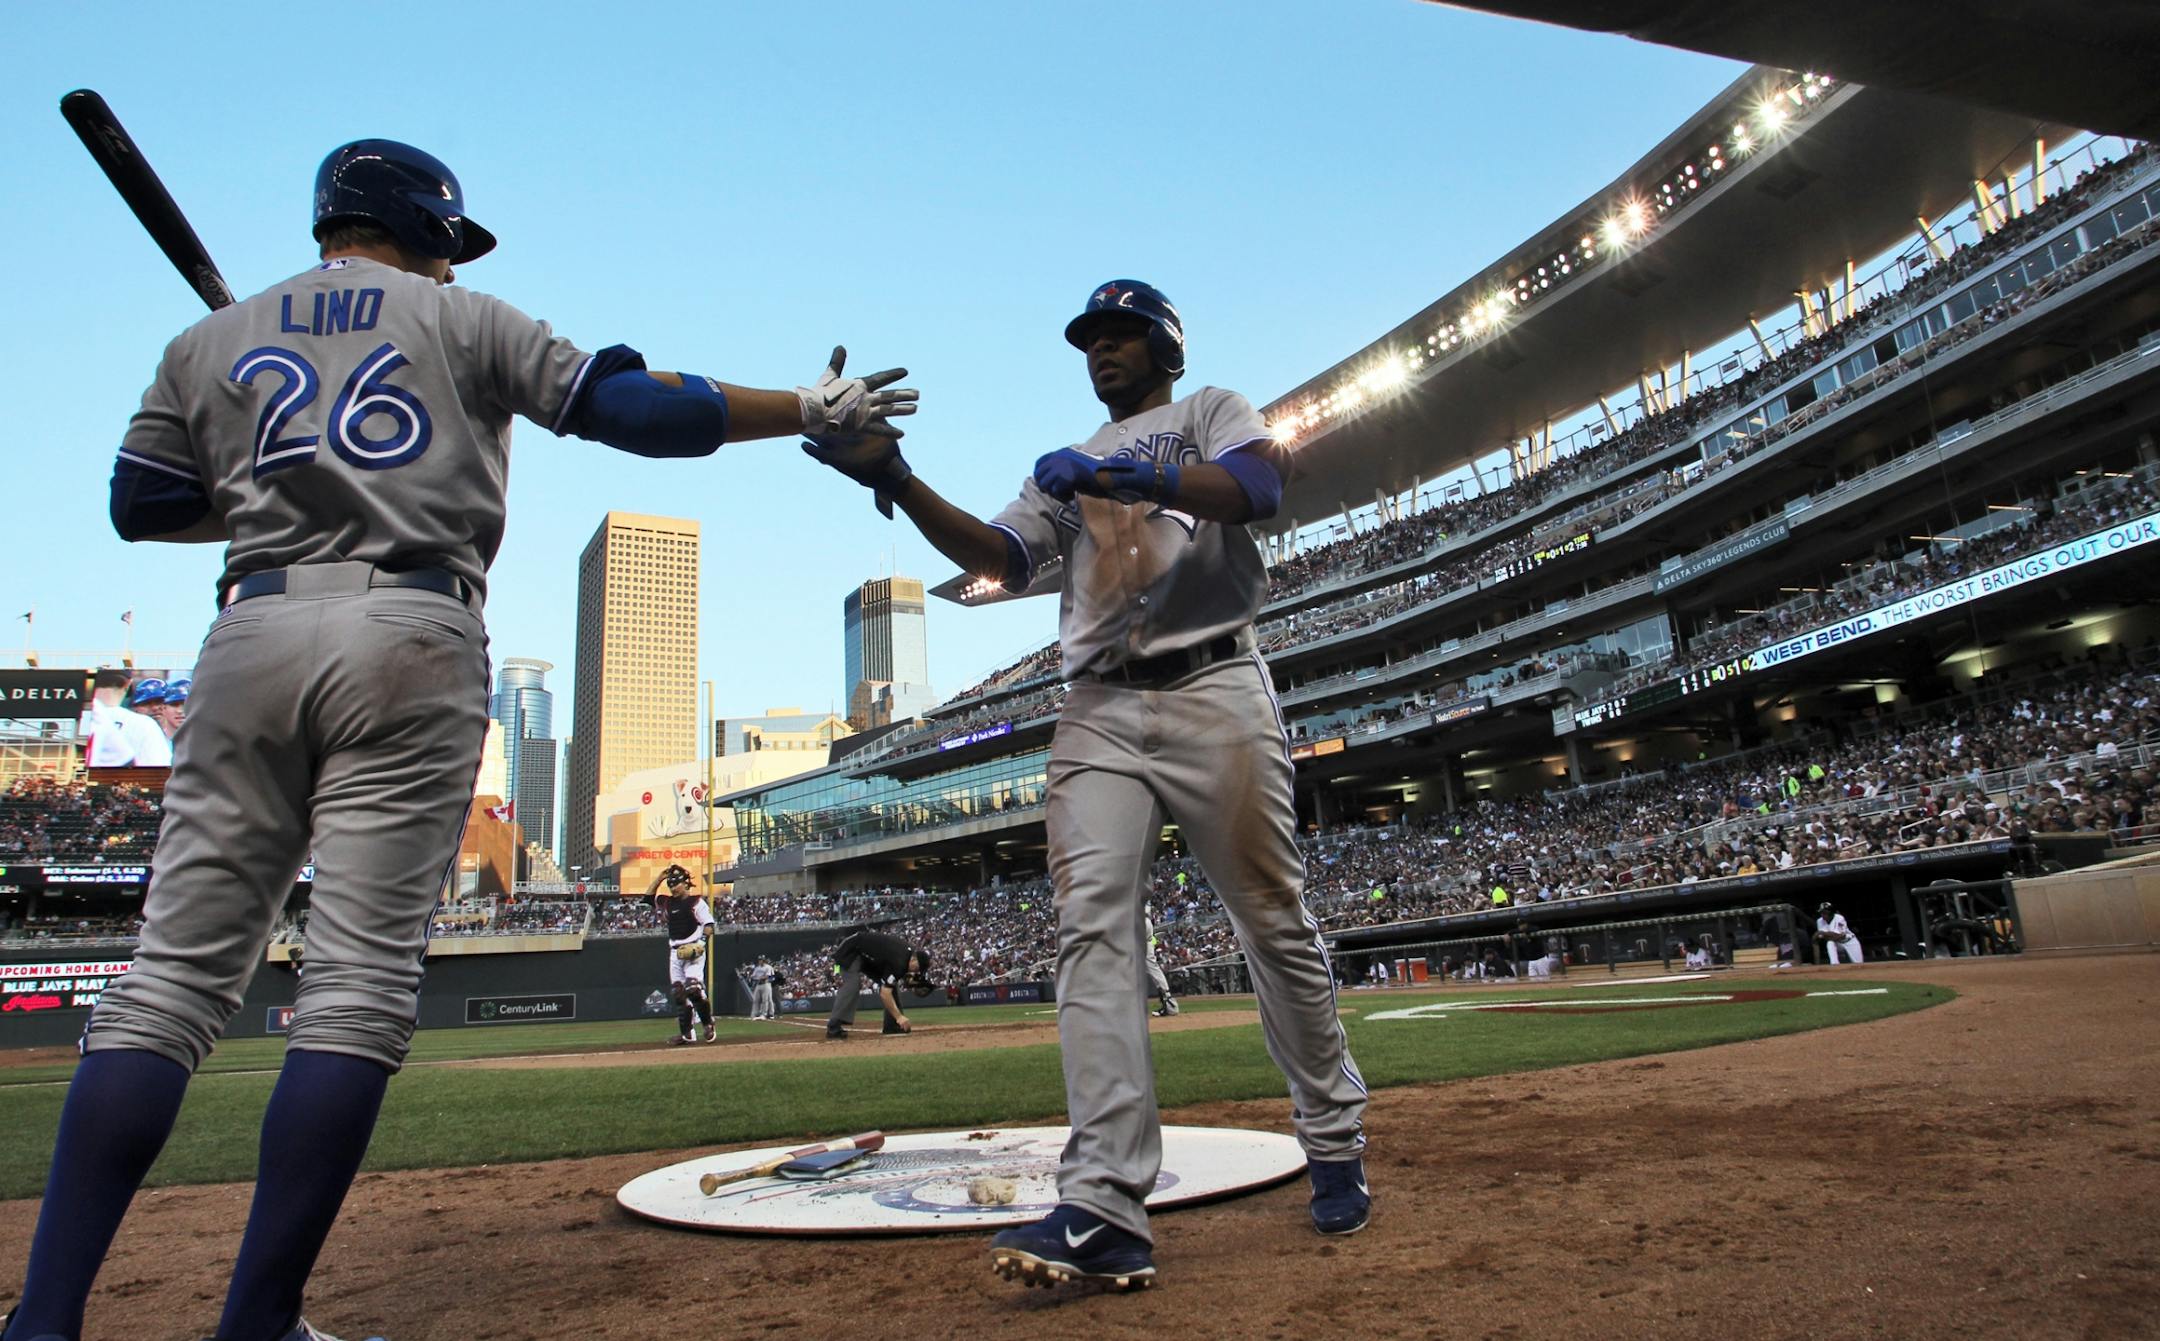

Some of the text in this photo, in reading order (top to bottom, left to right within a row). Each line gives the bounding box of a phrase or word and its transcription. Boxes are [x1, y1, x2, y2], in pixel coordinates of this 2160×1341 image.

[281, 288, 385, 336] LIND
[229, 342, 433, 482] 26
[1664, 568, 1691, 585] DELTA
[1724, 536, 1761, 559] LEGENDS
[1763, 526, 1786, 541] CLUB
[1762, 522, 2158, 664] WEST BEND. THE WORST BRINGS OUT OUR
[12, 688, 78, 700] DELTA
[626, 851, 664, 861] TARGET
[66, 965, 99, 974] HOME
[104, 963, 133, 972] GAM
[2, 981, 37, 993] BLUE
[38, 979, 72, 992] JAYS
[75, 978, 107, 990] MAY
[500, 1002, 559, 1014] CenturyLink
